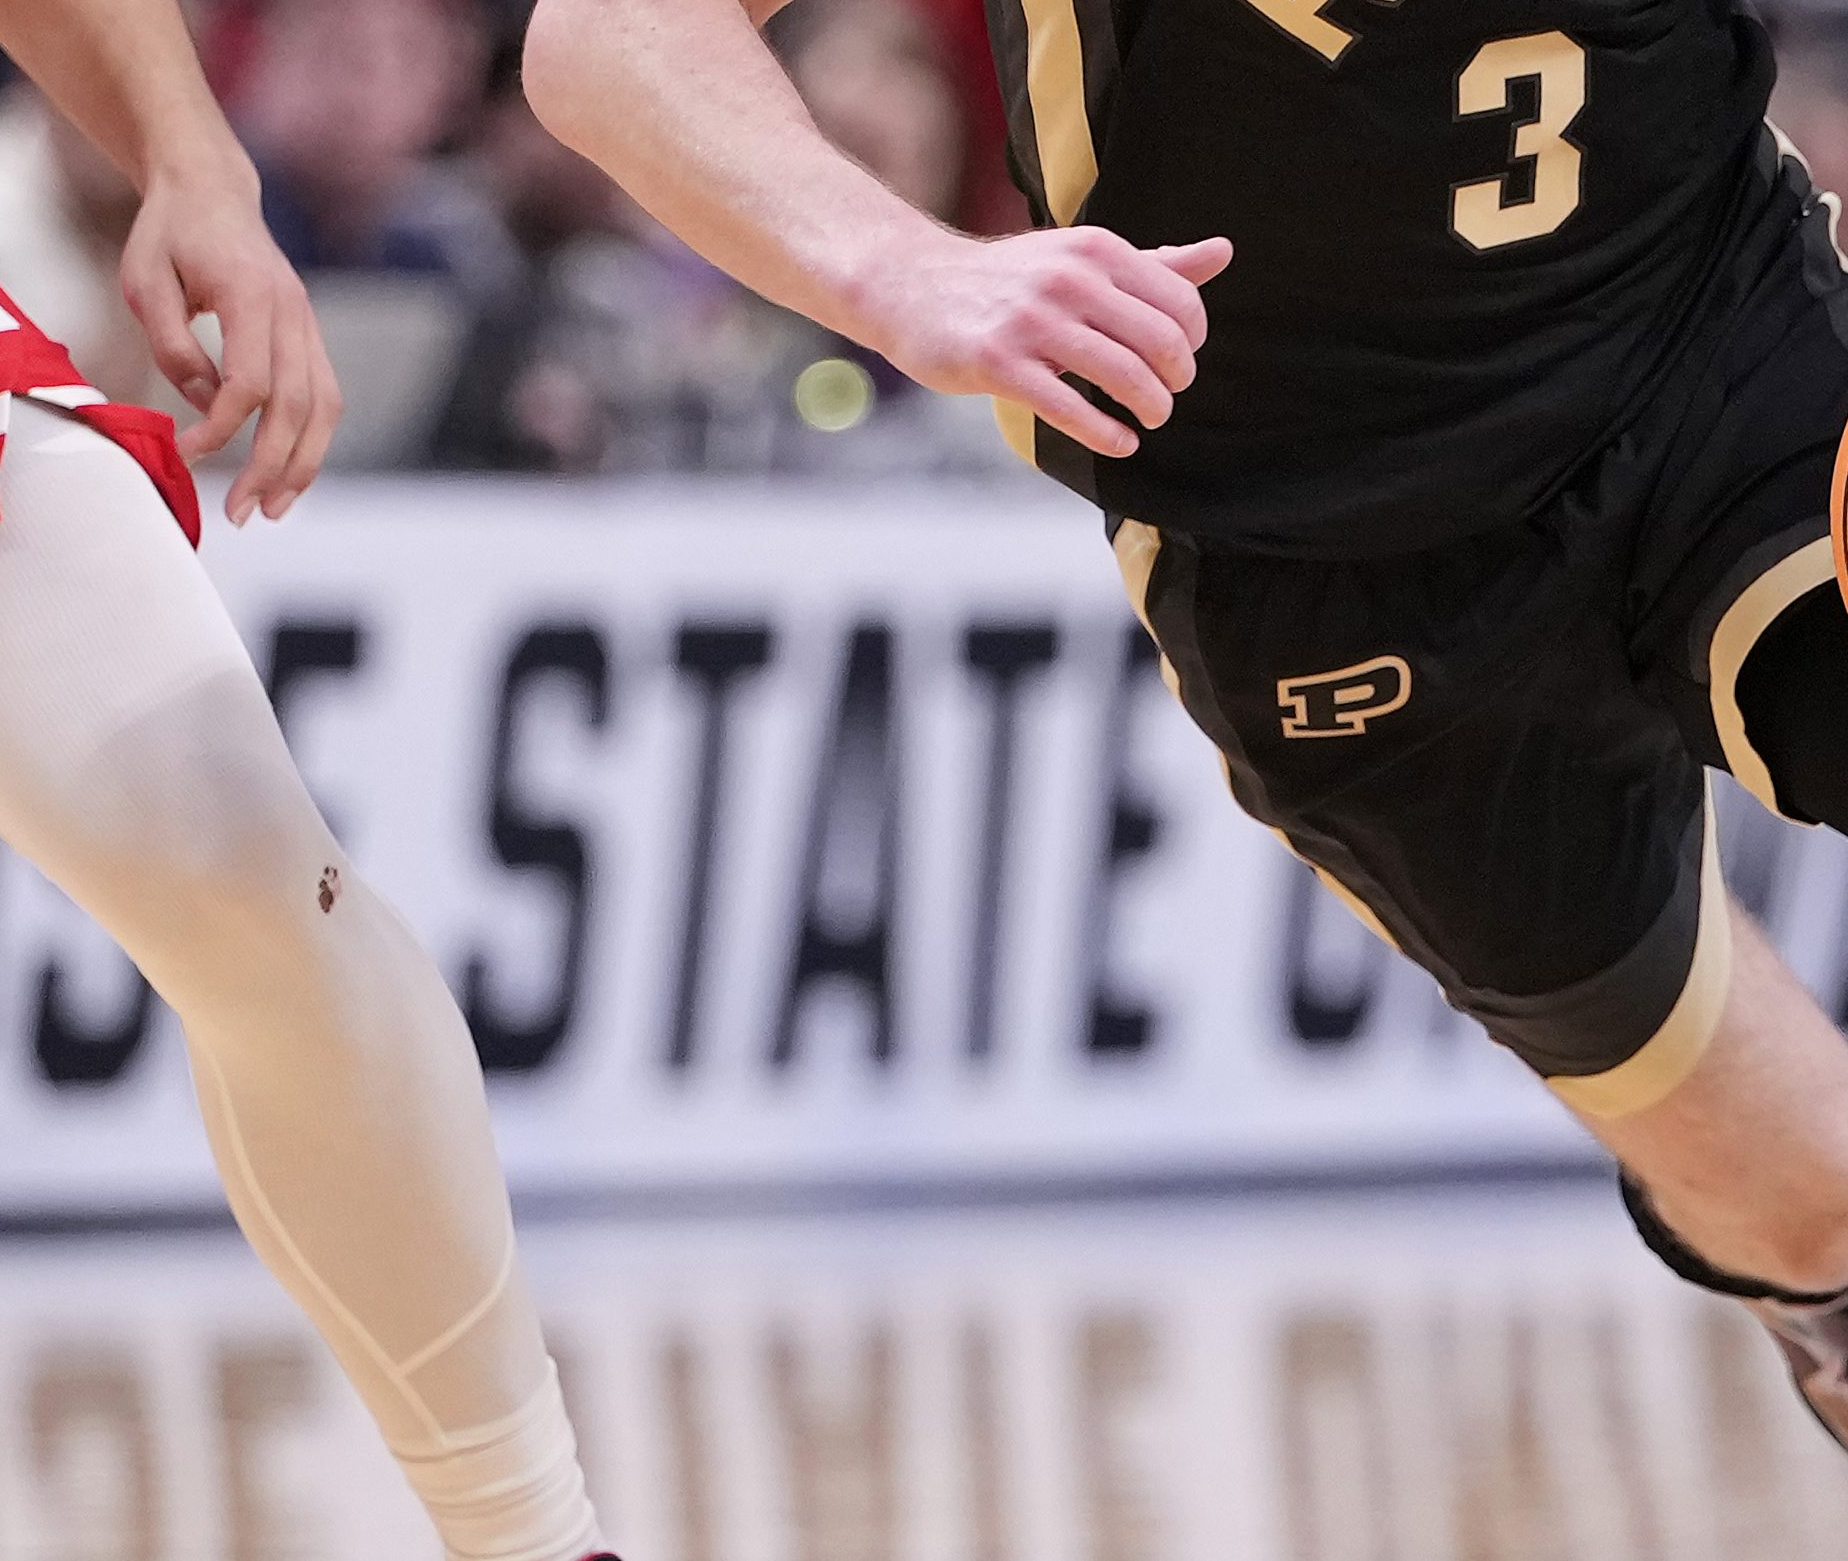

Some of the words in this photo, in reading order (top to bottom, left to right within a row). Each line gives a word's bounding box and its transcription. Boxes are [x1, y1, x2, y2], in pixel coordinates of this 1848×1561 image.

[1450, 30, 1588, 253] 3
[1277, 654, 1412, 738] P
[457, 620, 1160, 1068] STATE
